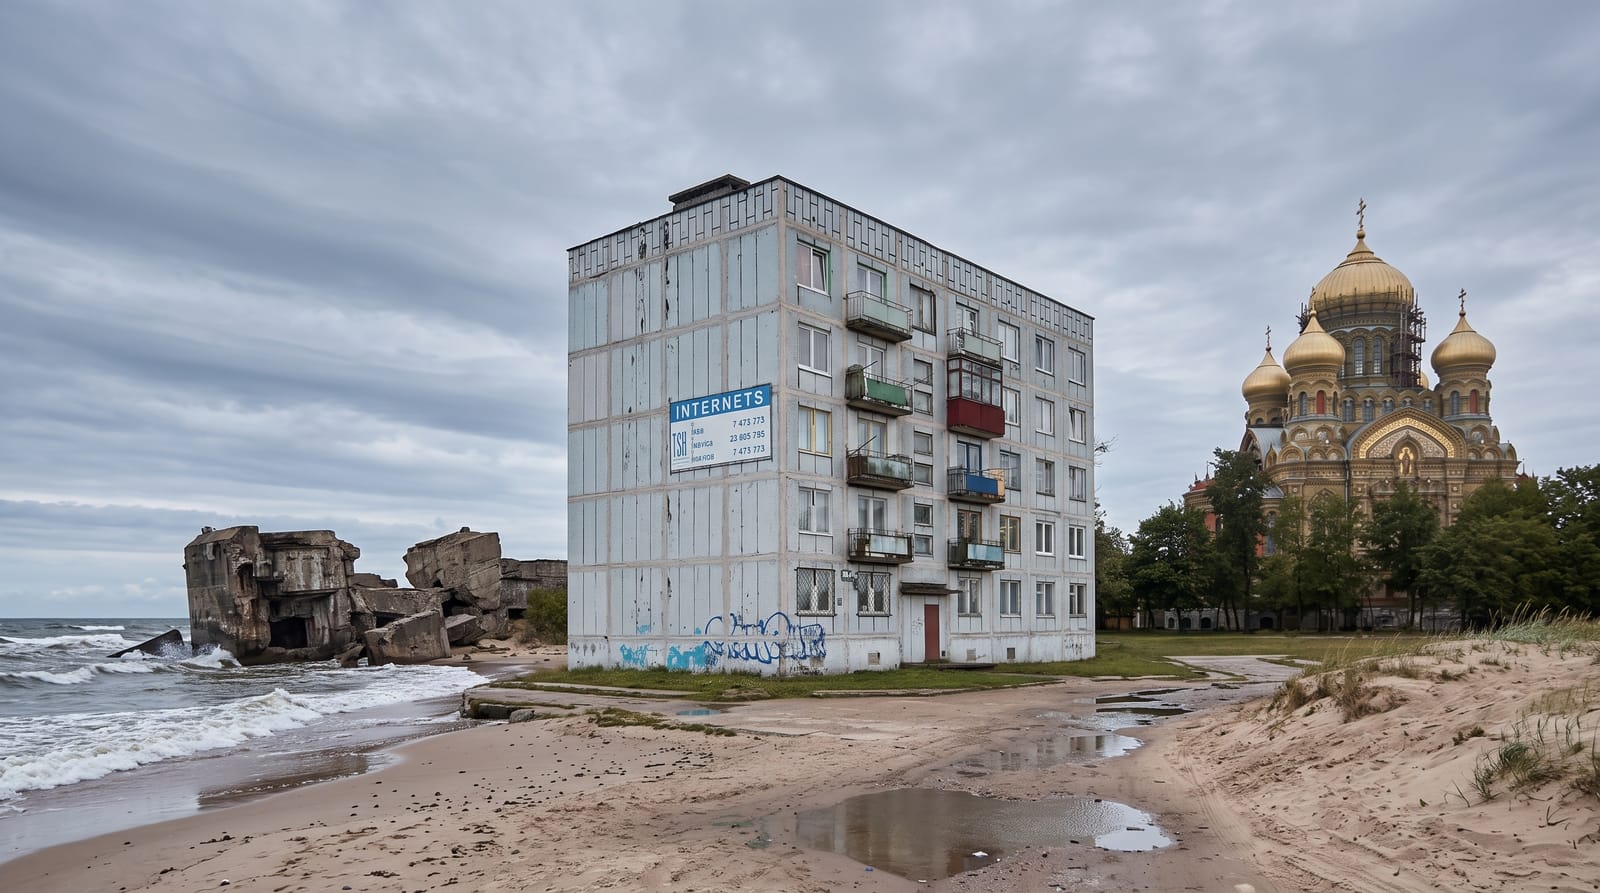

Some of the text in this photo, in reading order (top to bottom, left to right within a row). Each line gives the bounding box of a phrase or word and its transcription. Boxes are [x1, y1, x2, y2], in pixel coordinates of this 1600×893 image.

[676, 390, 763, 420] INTERNETS
[732, 420, 737, 428] 7
[738, 418, 751, 426] 473
[752, 416, 765, 425] 773
[730, 434, 738, 442] 23
[672, 431, 687, 458] TSH
[733, 448, 737, 456] 7
[738, 446, 751, 455] 473
[753, 444, 765, 453] 773
